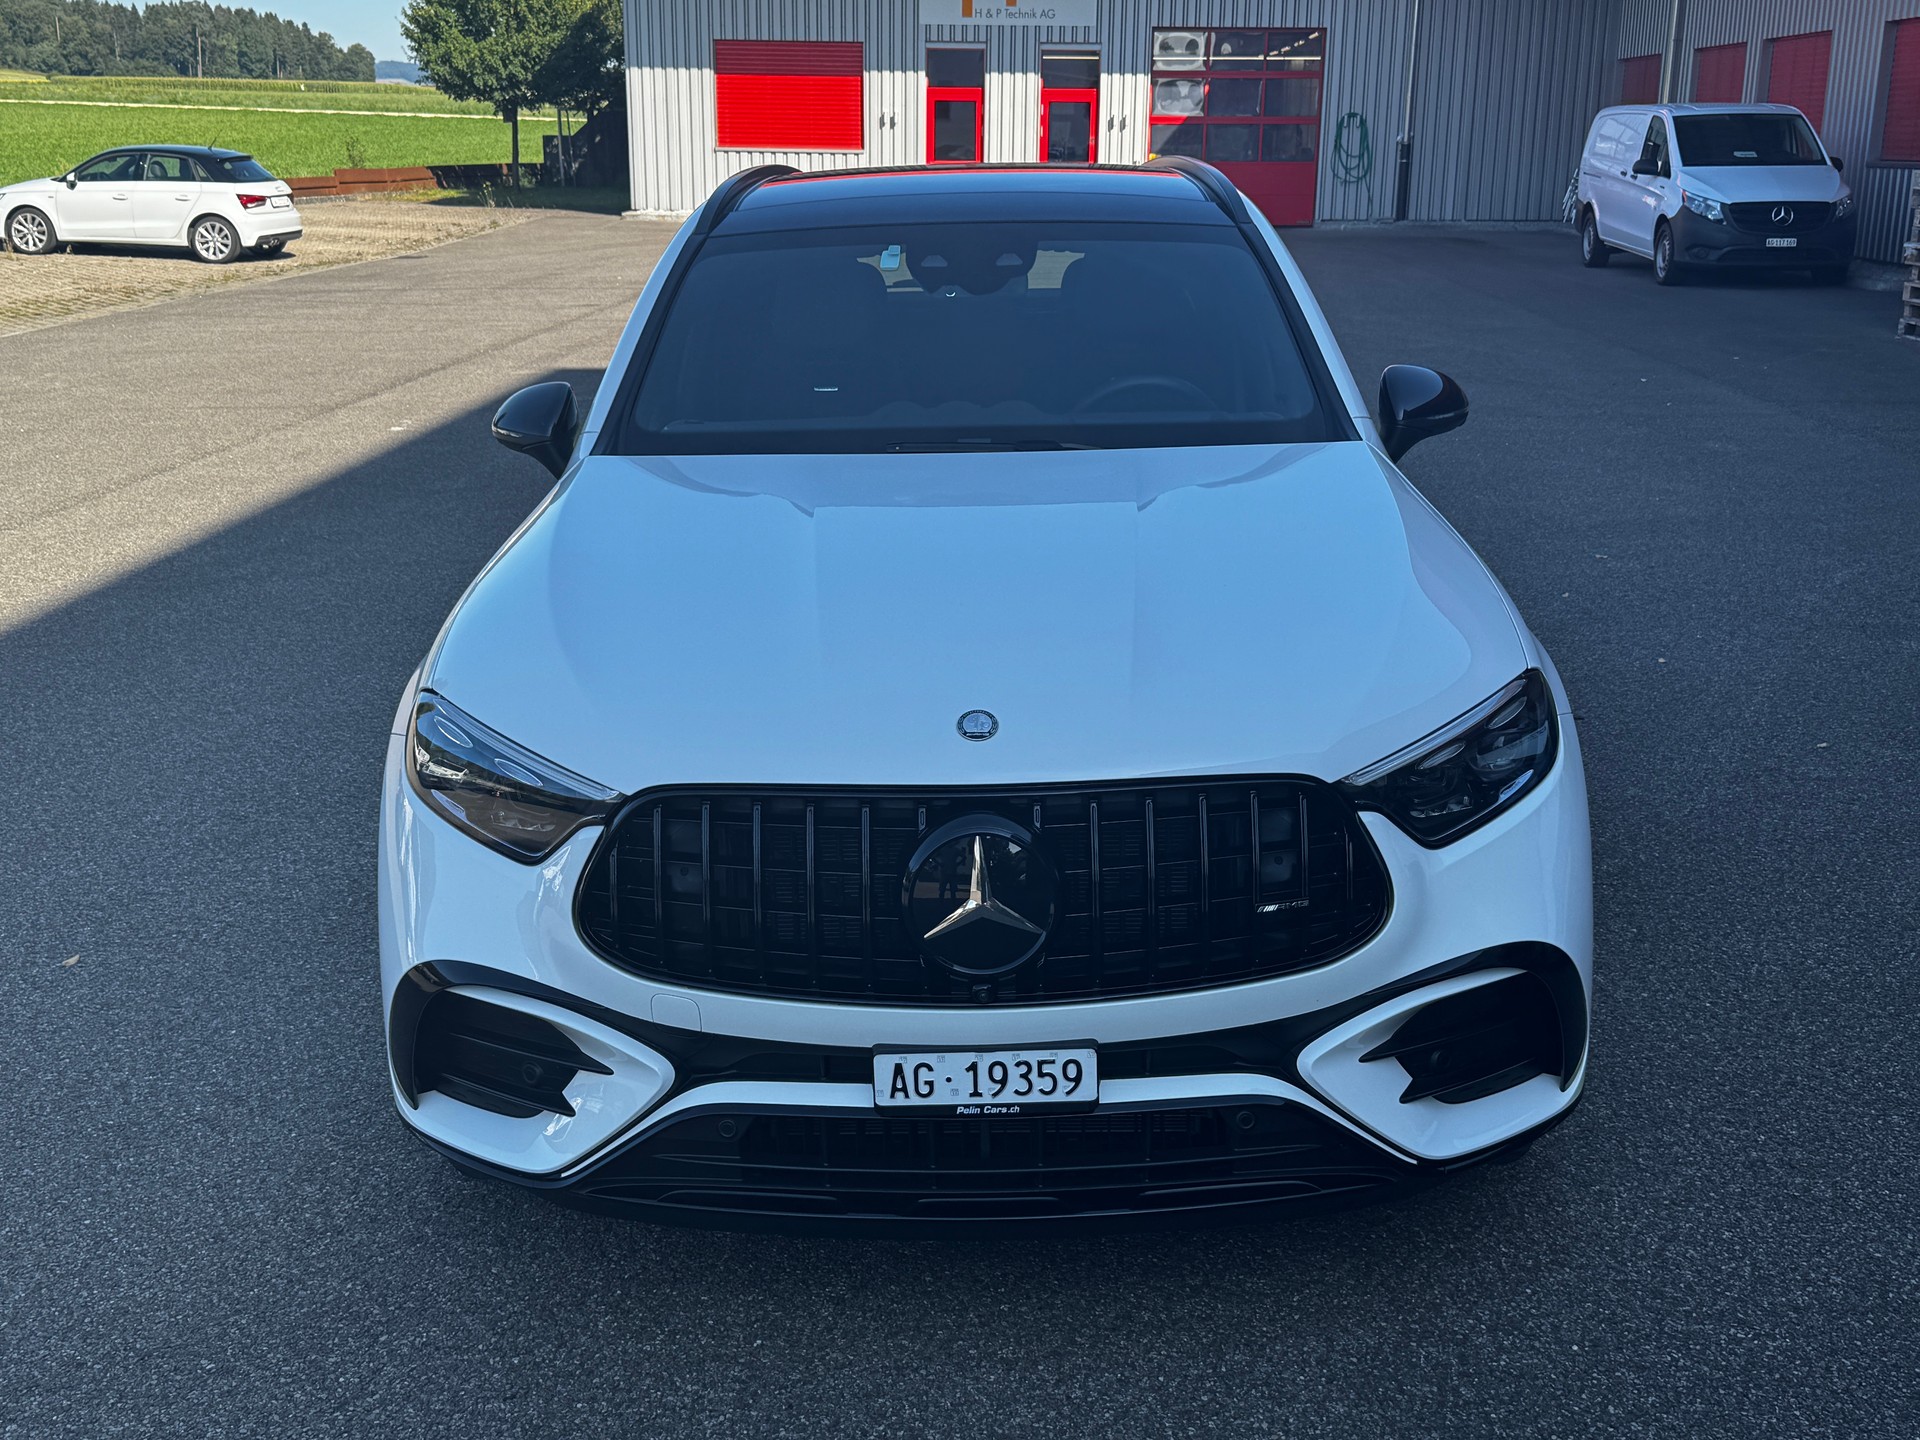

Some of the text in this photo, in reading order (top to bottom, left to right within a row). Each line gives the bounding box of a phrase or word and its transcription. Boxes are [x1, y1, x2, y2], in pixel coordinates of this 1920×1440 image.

[974, 8, 1056, 20] H & P Technik AG
[956, 1104, 1020, 1115] Pelin Cars.ch
